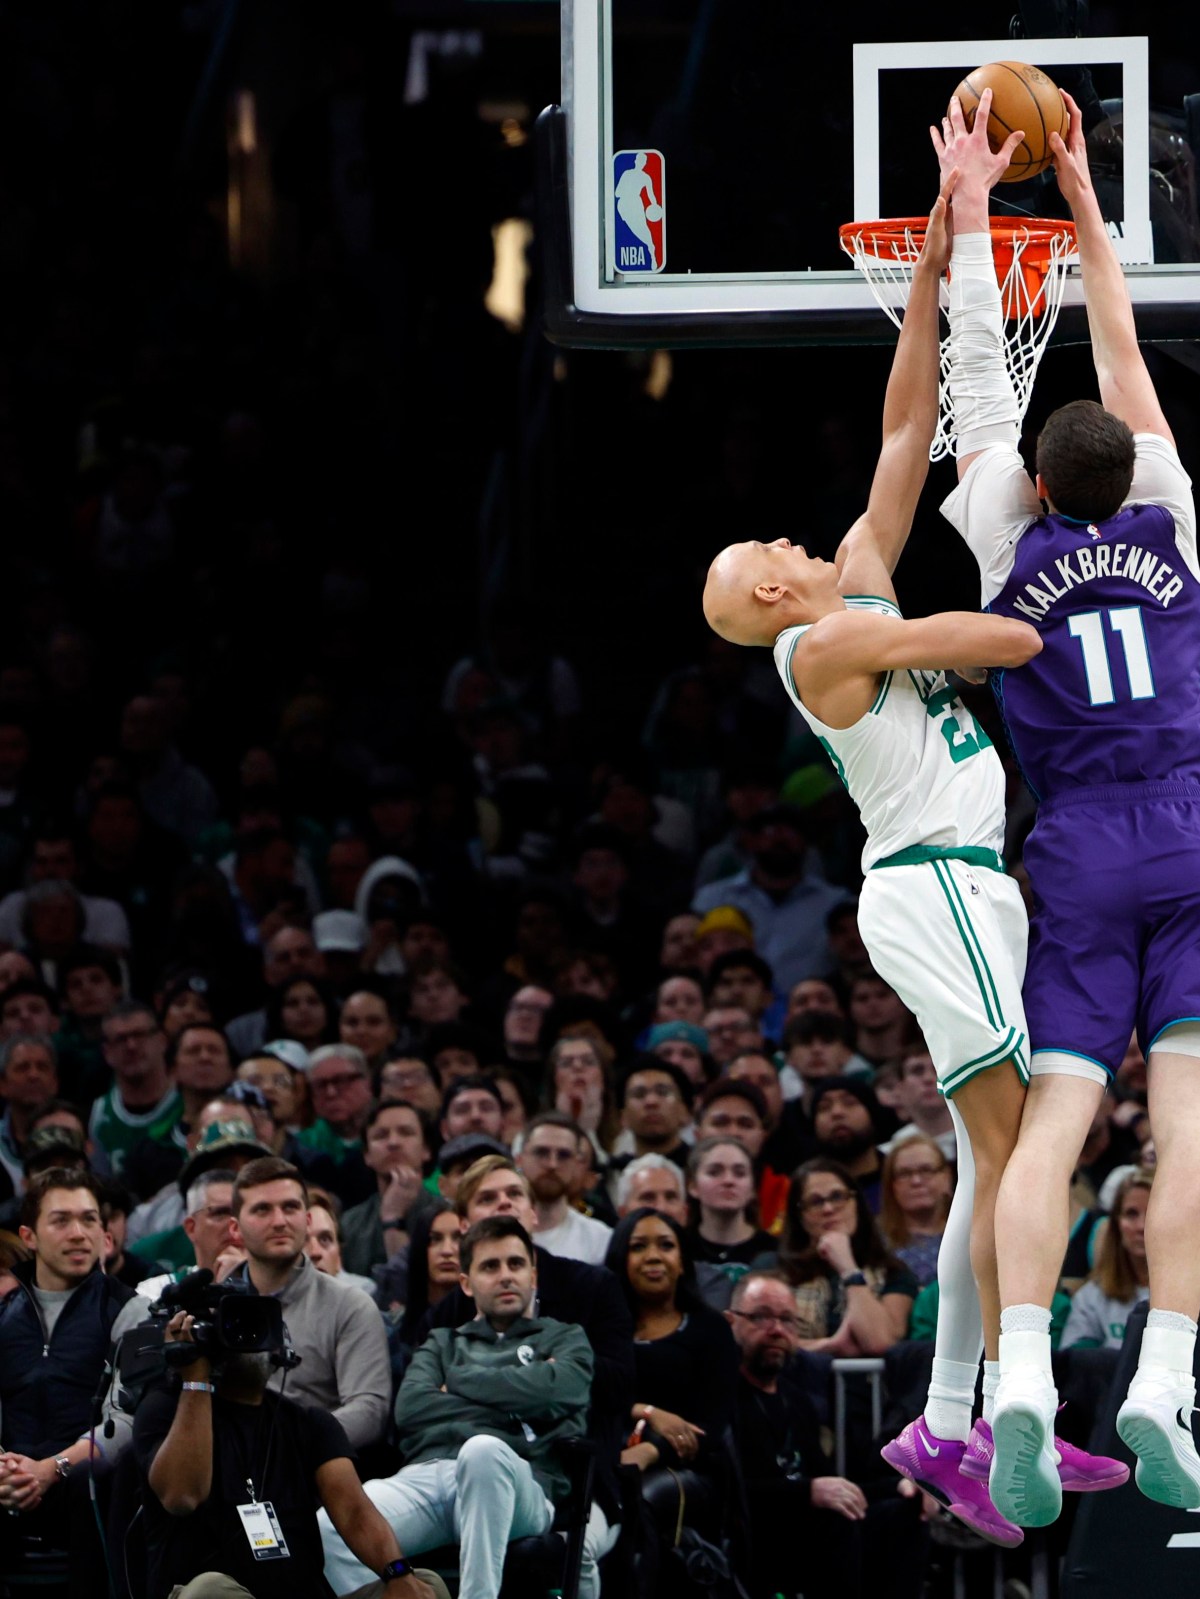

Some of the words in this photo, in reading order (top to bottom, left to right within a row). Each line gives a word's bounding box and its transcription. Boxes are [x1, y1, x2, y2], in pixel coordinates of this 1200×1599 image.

[620, 246, 646, 267] NBA
[1012, 543, 1184, 622] KALKBRENNER
[1066, 604, 1157, 707] 11
